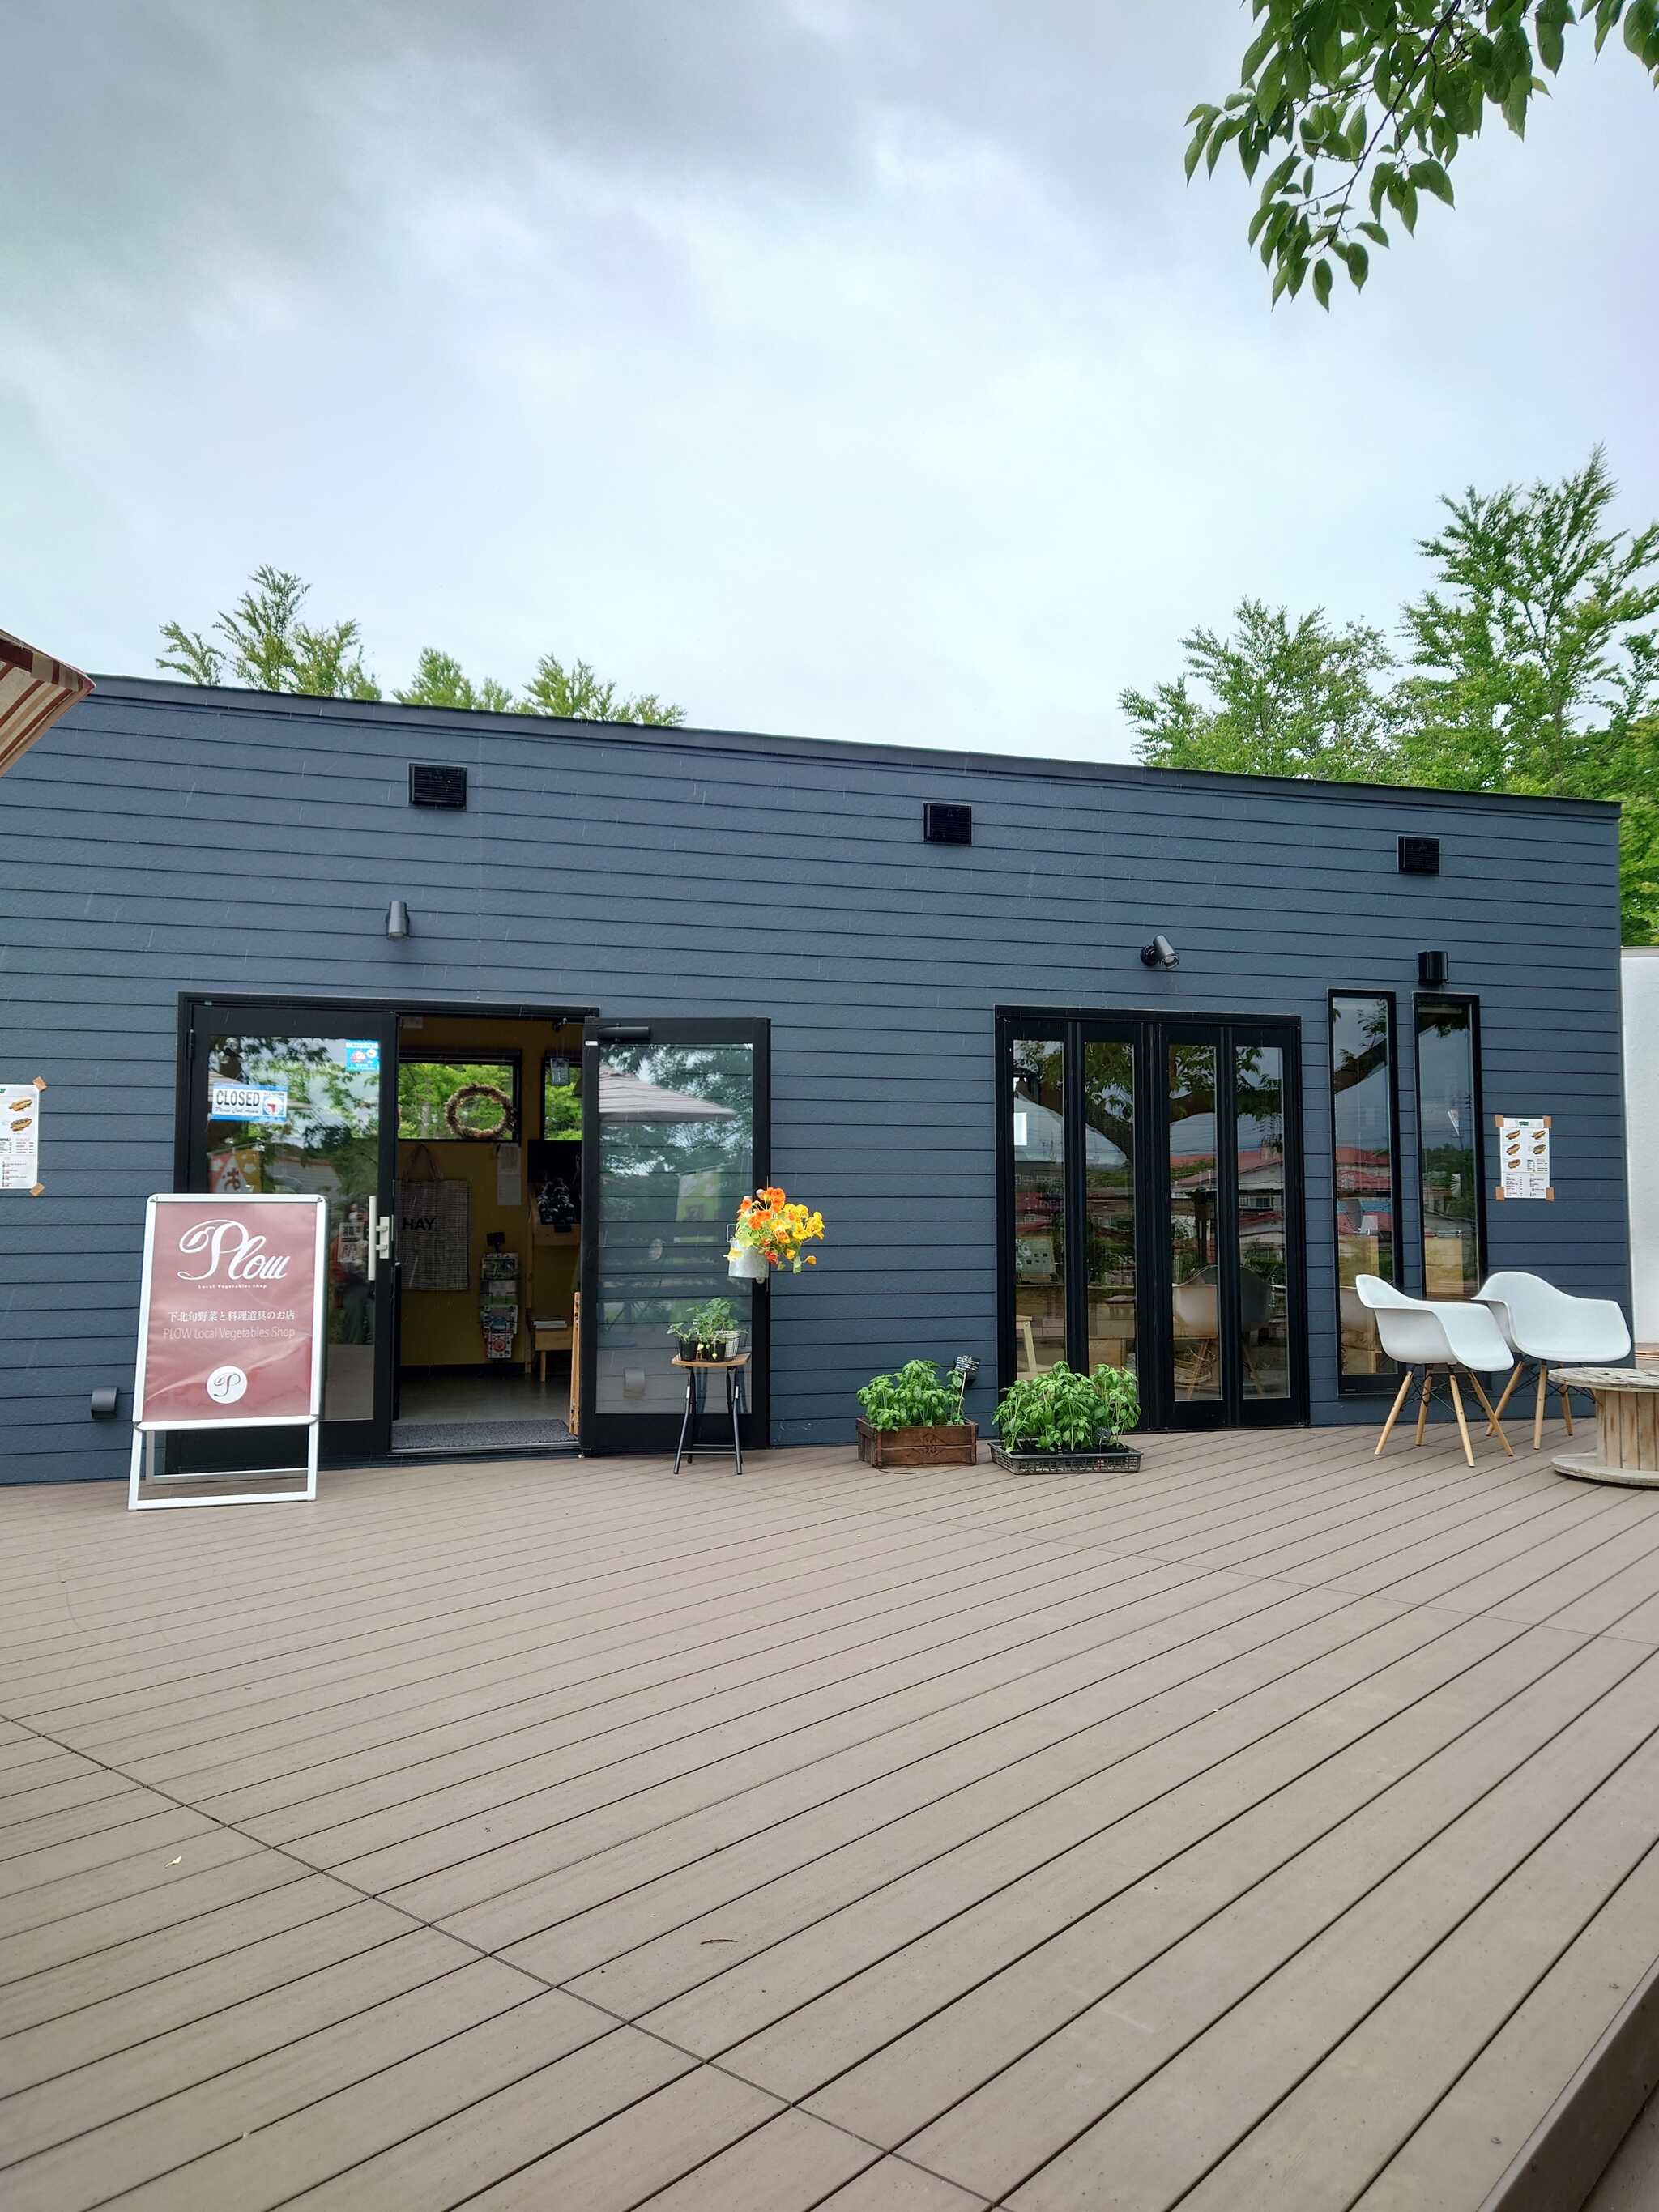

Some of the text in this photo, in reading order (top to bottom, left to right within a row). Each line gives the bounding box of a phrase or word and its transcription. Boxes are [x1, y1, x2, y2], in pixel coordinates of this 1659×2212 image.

[216, 1090, 260, 1106] CLOSED
[403, 1217, 436, 1231] HAY
[163, 1325, 296, 1341] PLOW Local Vegetables Shop
